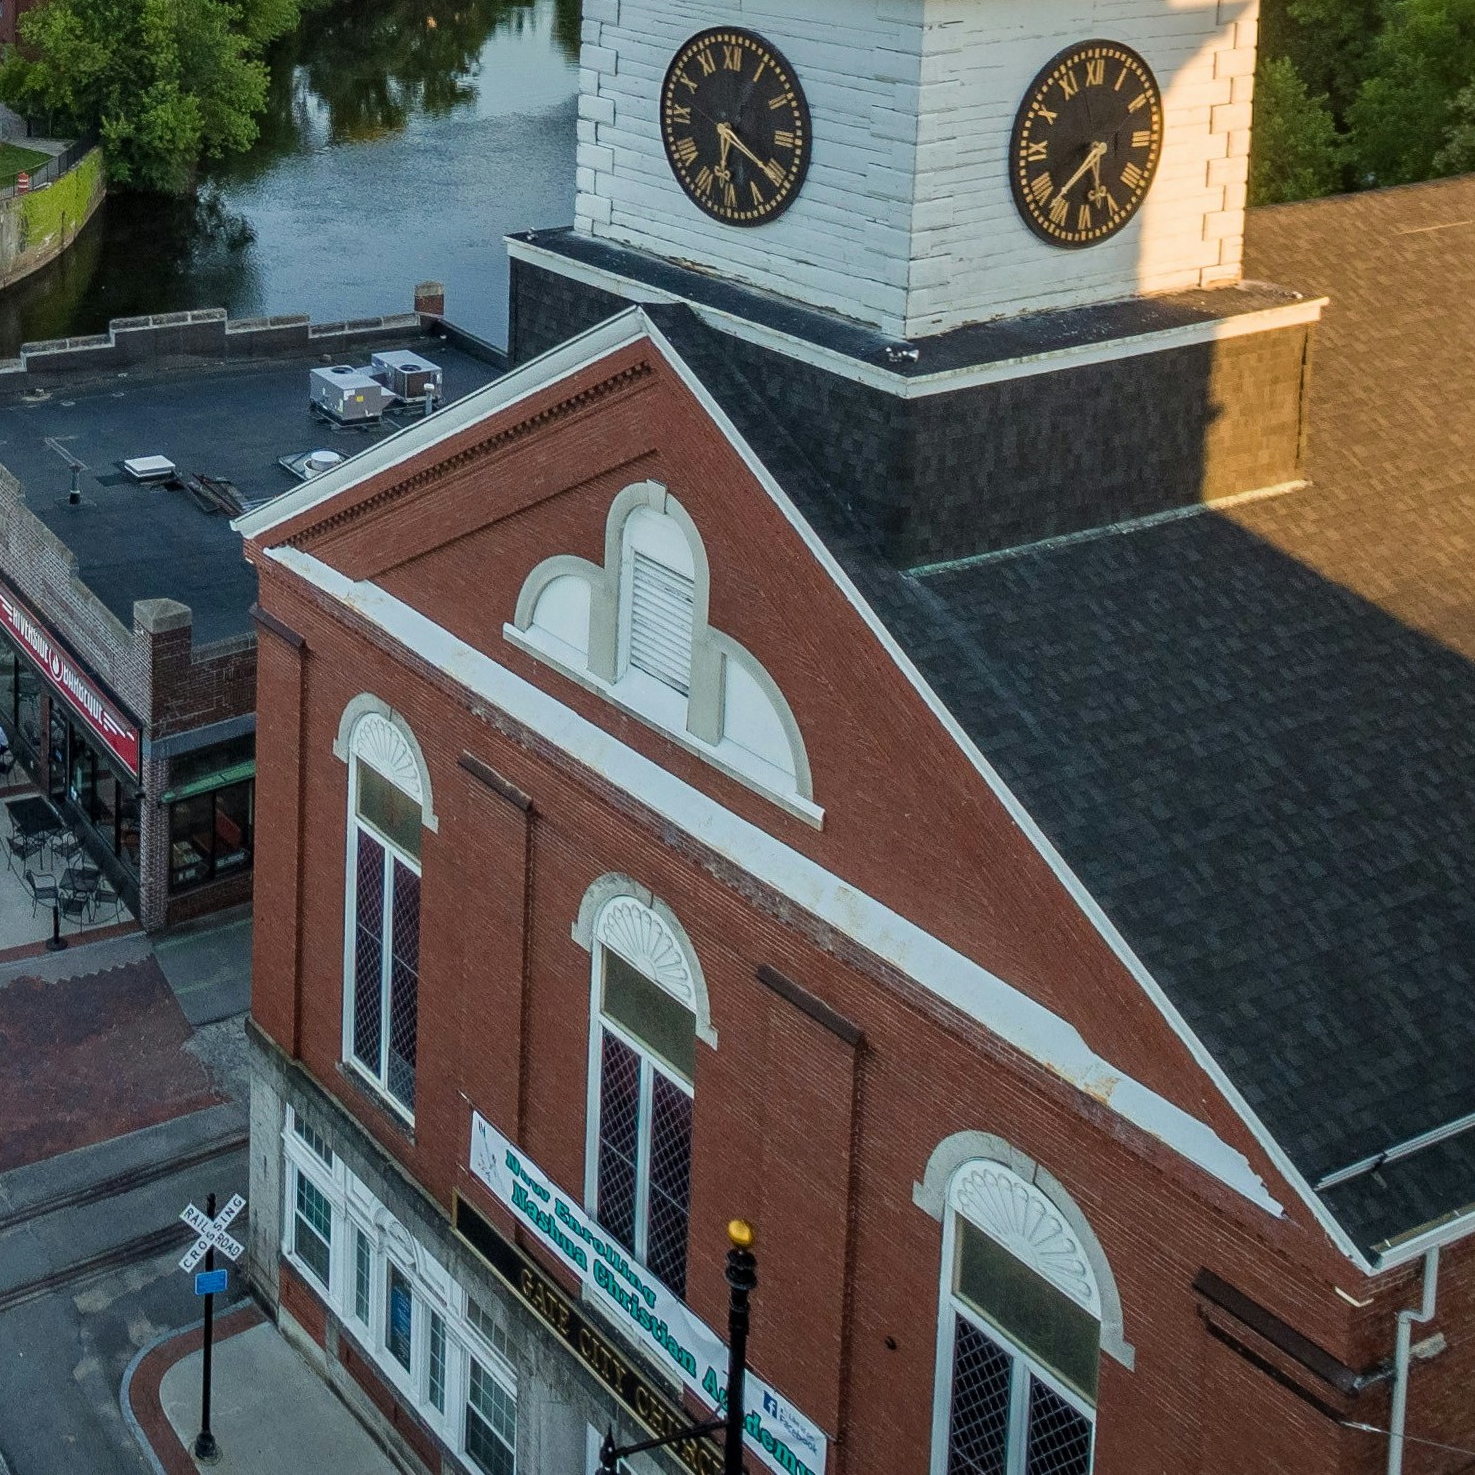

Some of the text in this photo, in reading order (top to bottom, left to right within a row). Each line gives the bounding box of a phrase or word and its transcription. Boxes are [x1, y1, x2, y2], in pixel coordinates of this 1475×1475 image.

[506, 1148, 656, 1308] Now Enrolling
[512, 1180, 588, 1272] Nashua
[593, 1259, 697, 1379] Christian
[521, 1268, 570, 1341] GATE
[579, 1328, 627, 1394] CITY
